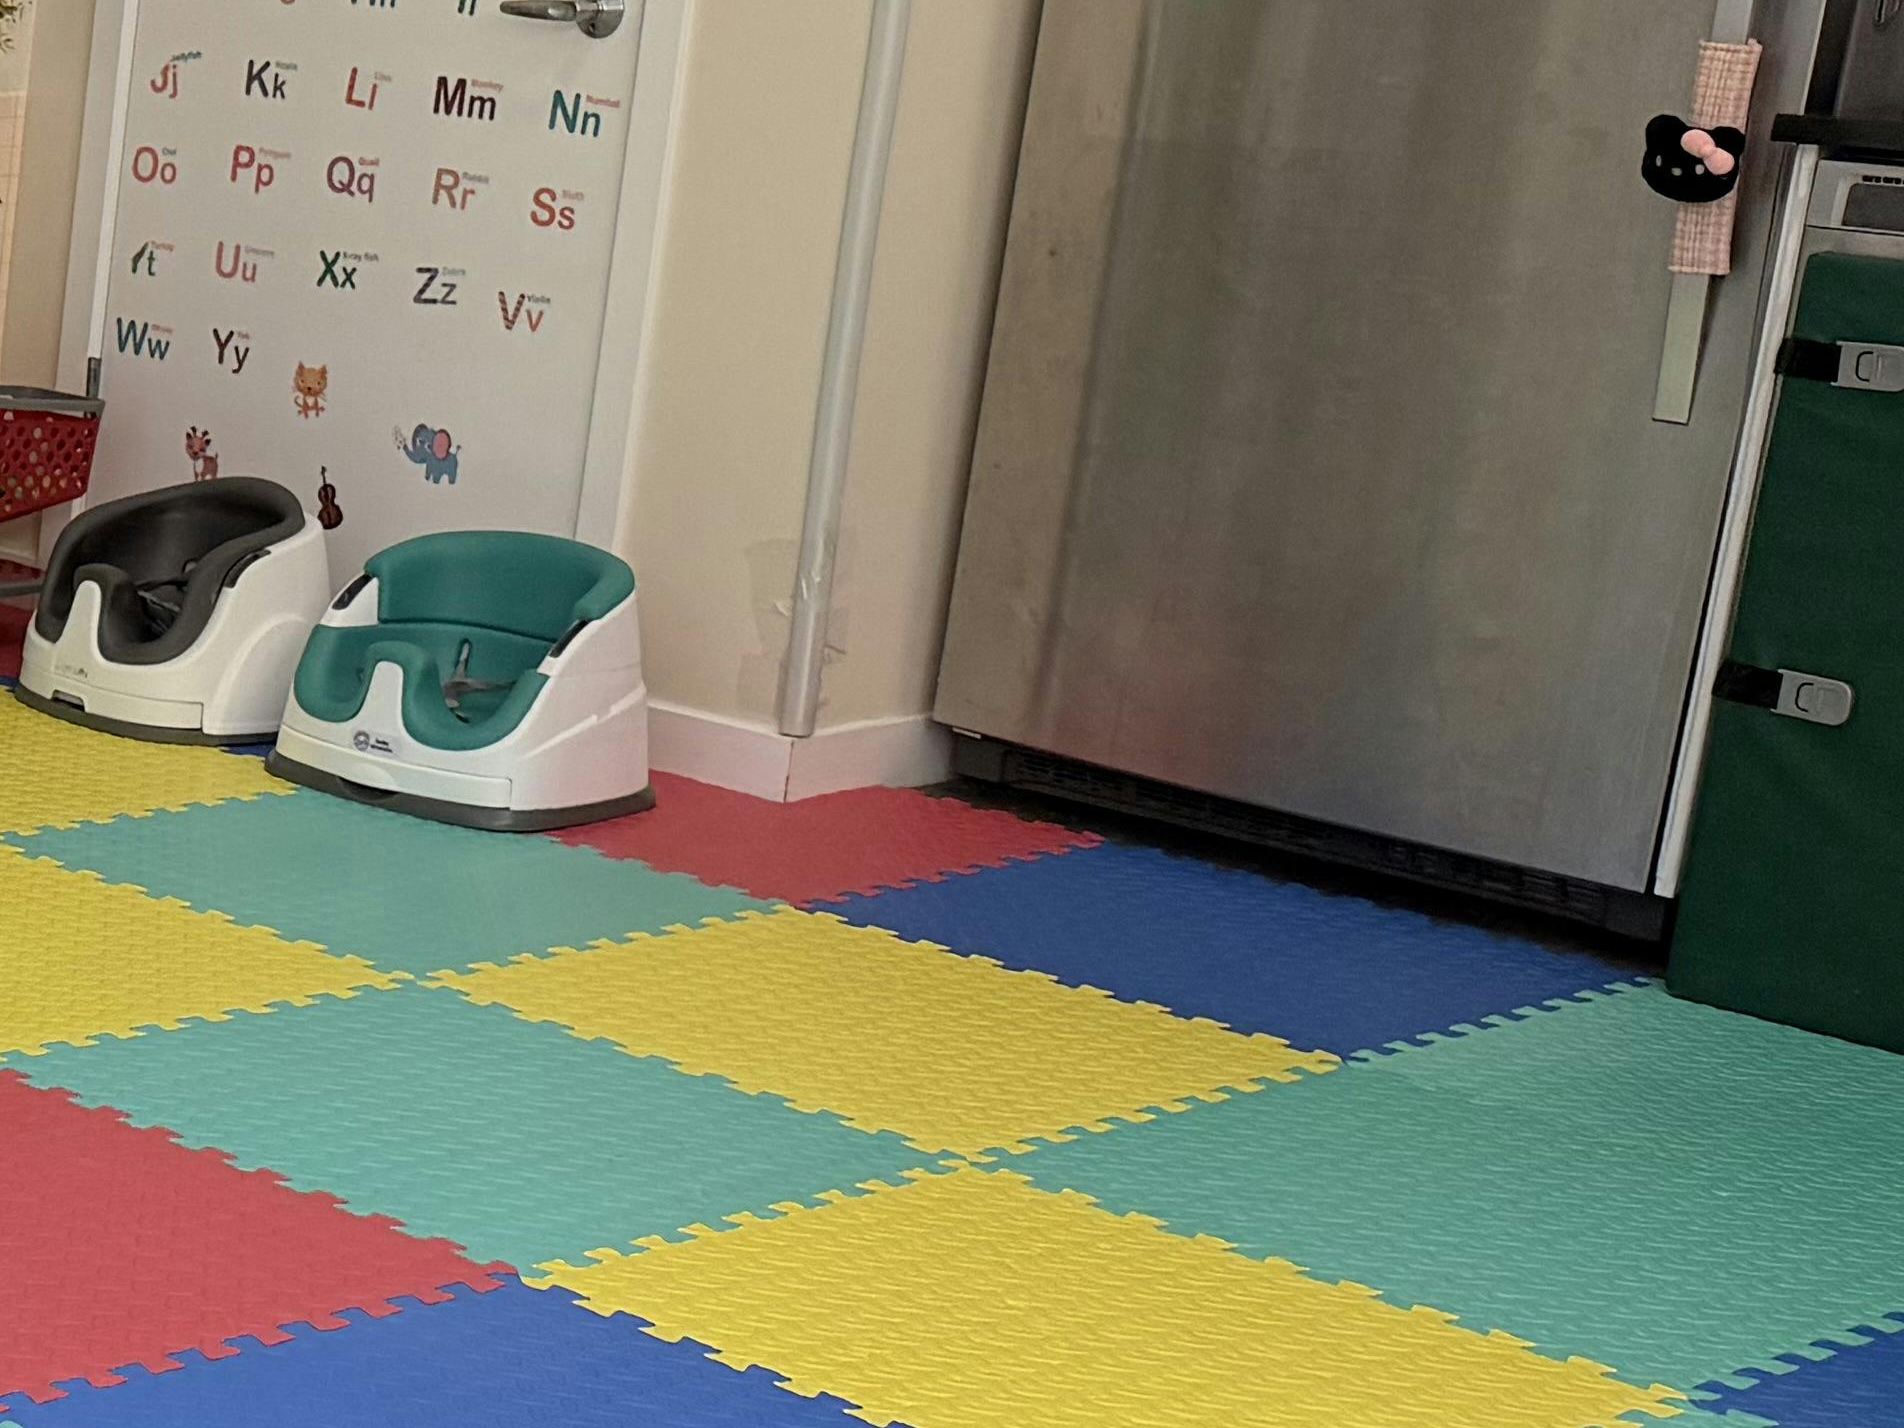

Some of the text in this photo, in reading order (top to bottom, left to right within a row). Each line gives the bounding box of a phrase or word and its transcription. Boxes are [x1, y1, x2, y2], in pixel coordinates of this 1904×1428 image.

[150, 63, 178, 99] Jj
[245, 59, 287, 100] Kk
[433, 75, 497, 122] Mm
[548, 89, 601, 138] Nn
[132, 146, 177, 185] Oo
[230, 144, 275, 194] Pp
[326, 156, 375, 203] Qq
[431, 167, 476, 211] Rr
[530, 187, 576, 231] Ss
[215, 241, 258, 284] Uu
[316, 250, 357, 290] Xx
[413, 267, 458, 306] Zz
[498, 290, 545, 333] Vv
[116, 316, 170, 361] Ww
[213, 328, 251, 374] Yy
